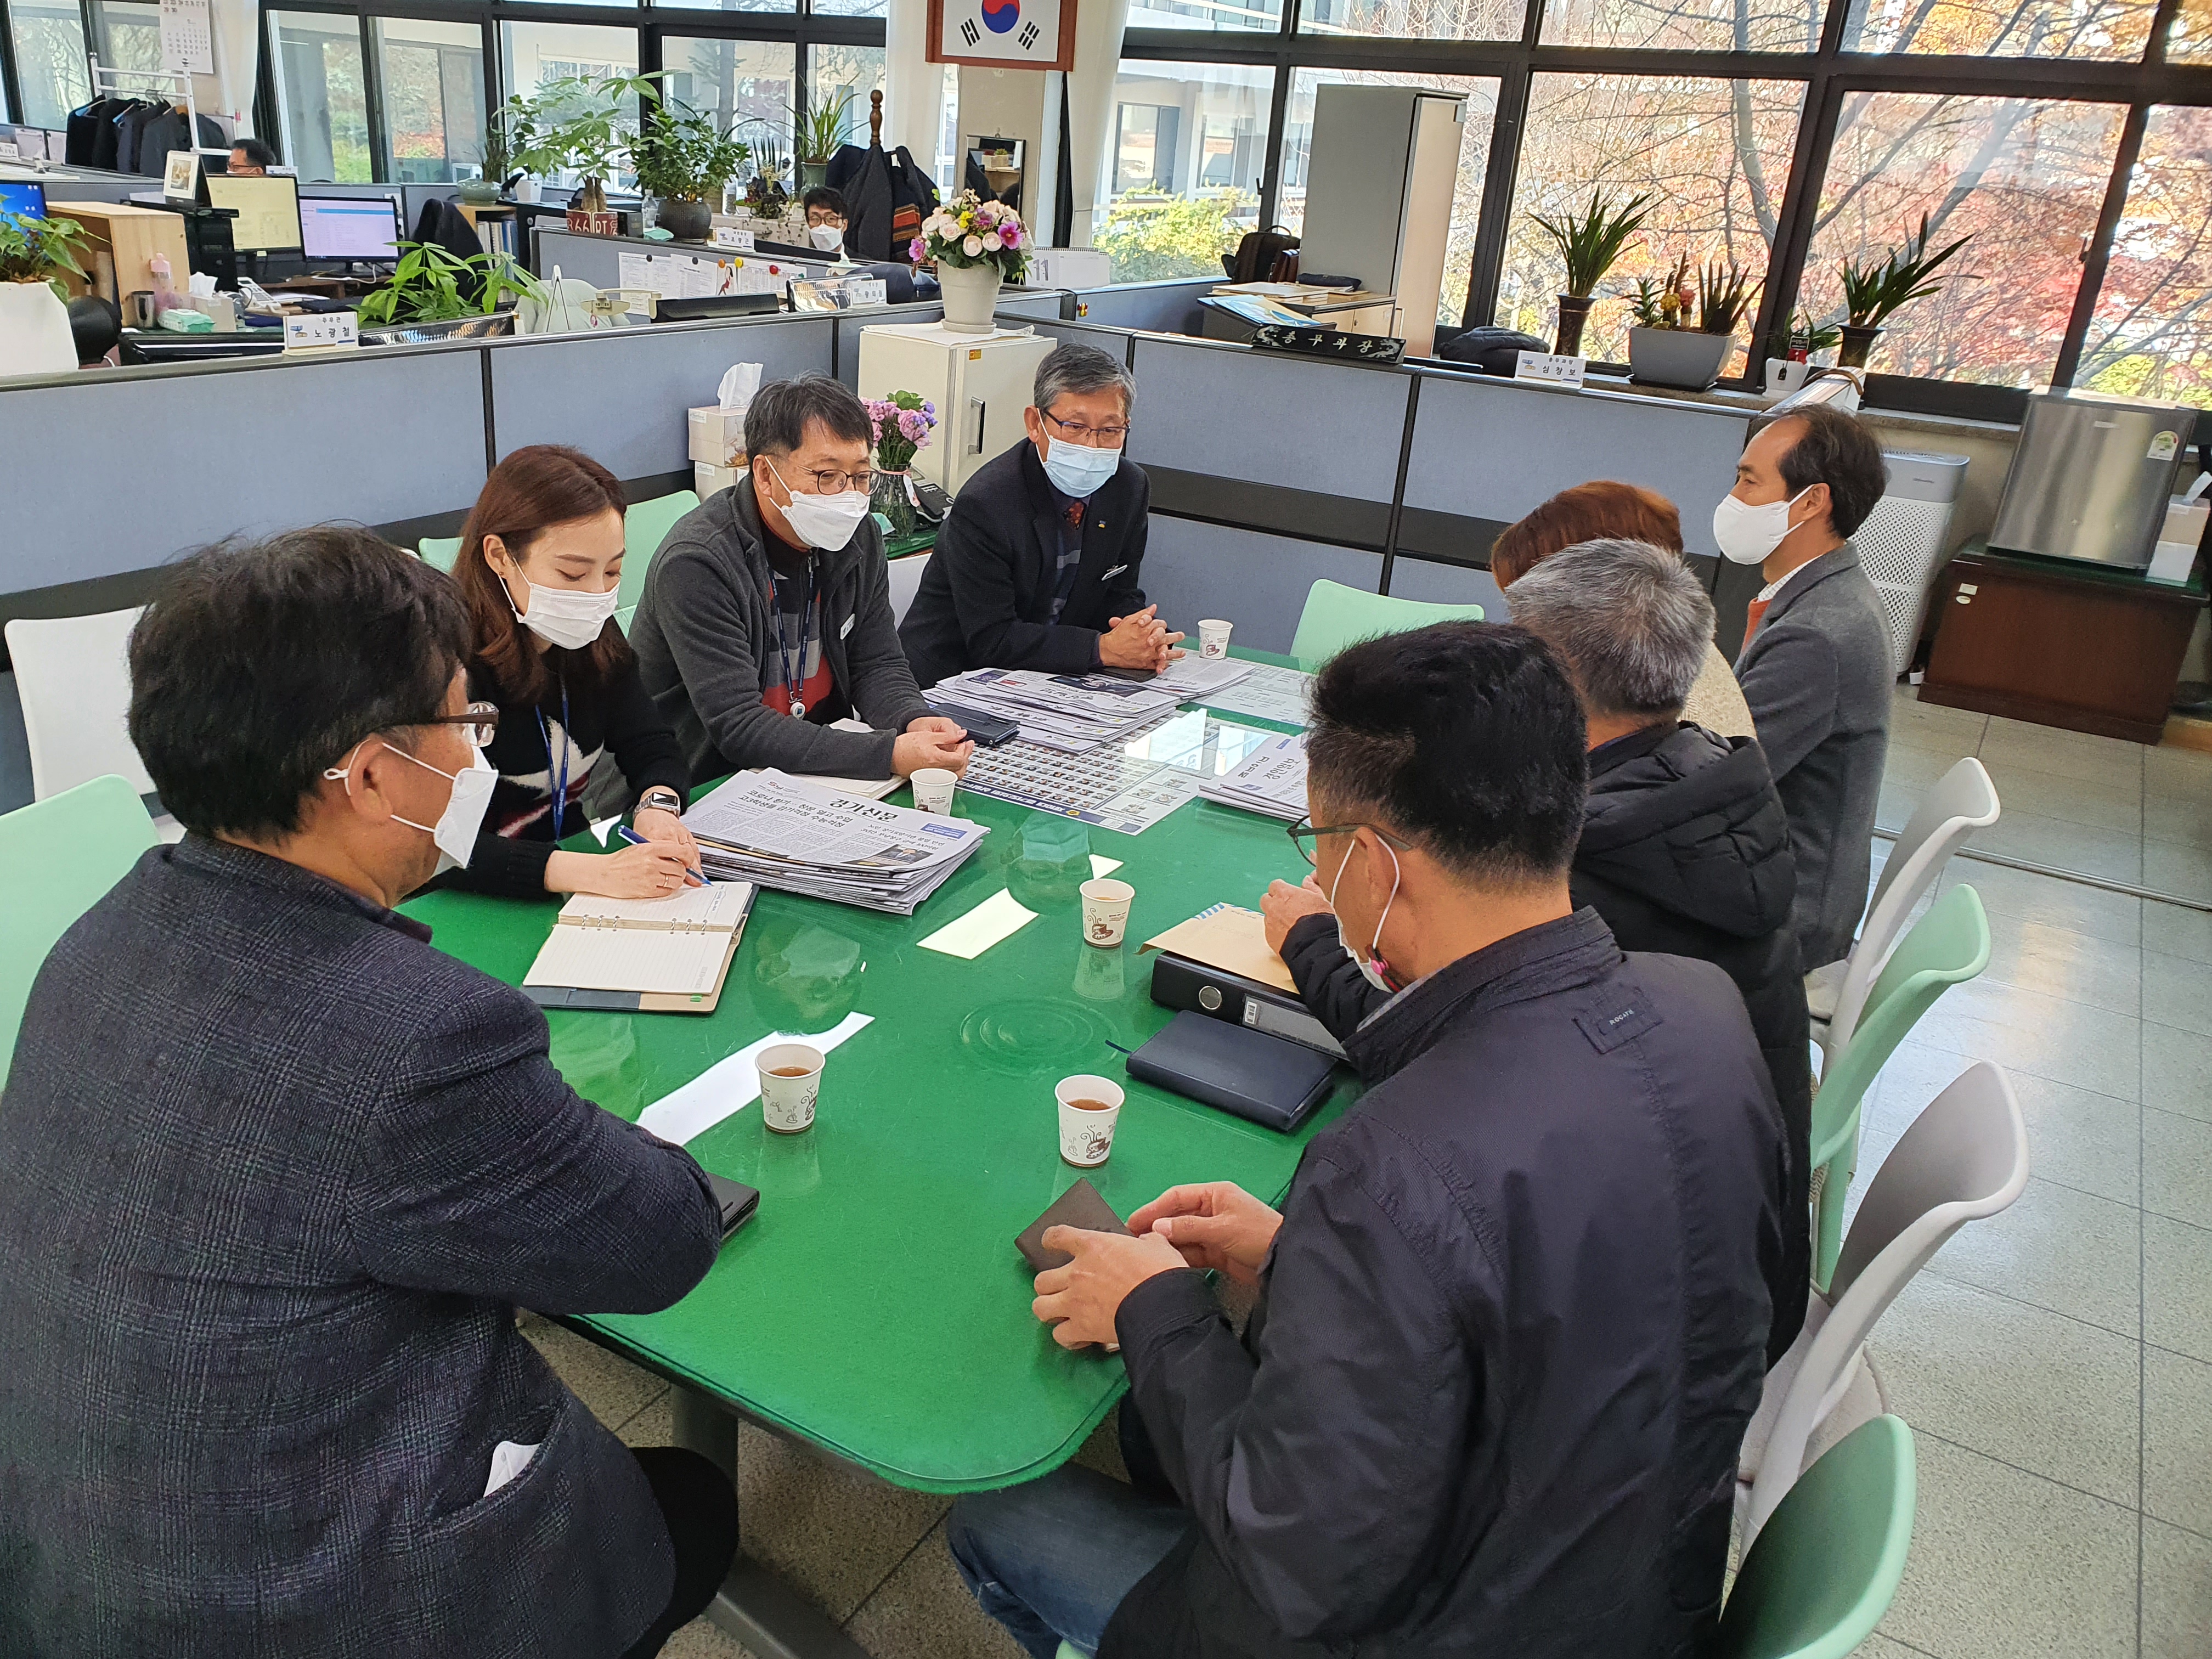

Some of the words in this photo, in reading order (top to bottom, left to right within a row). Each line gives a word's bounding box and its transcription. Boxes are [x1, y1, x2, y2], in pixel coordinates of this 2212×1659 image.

[1033, 259, 1049, 281] 11
[314, 326, 350, 338] 노광철
[1282, 330, 1373, 353] 총무과장
[1542, 365, 1576, 376] 심창보
[1263, 758, 1301, 780] 경인일보
[747, 789, 774, 801] 코로나
[834, 815, 854, 823] 수업
[829, 798, 899, 822] 경기신문
